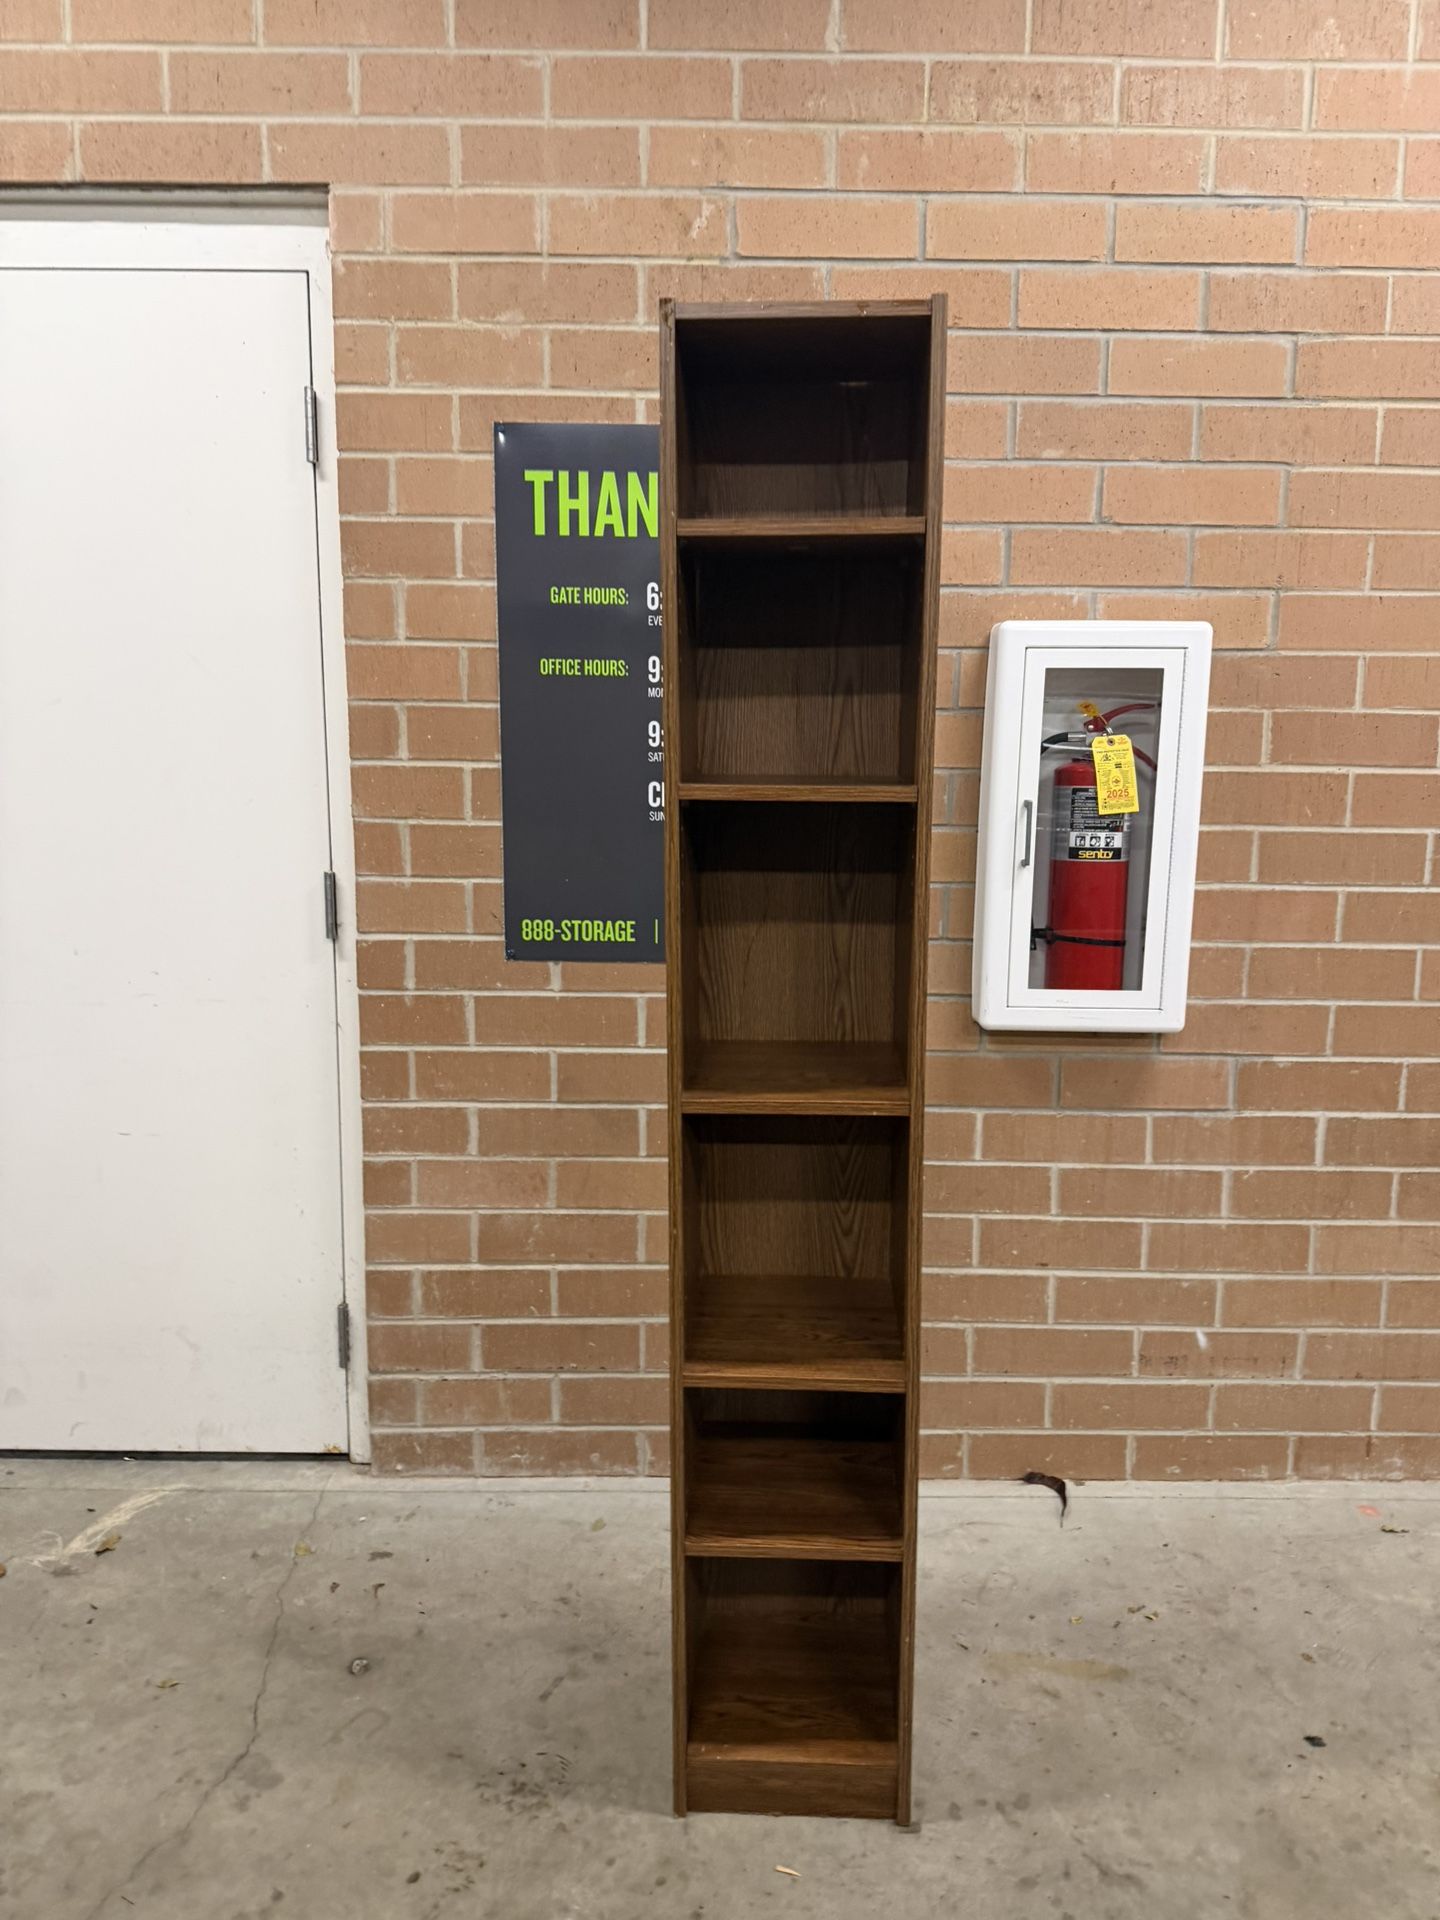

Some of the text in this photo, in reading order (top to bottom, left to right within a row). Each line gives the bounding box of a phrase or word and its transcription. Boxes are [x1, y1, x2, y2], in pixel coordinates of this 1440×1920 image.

[524, 470, 659, 538] THAN
[550, 586, 581, 604] GATE
[584, 587, 629, 605] HOURS:
[540, 658, 581, 676] OFFICE
[584, 659, 629, 677] HOURS:
[648, 751, 665, 762] SAT
[1106, 788, 1130, 799] 2025
[1078, 849, 1114, 859] sentry
[521, 918, 636, 942] 888-STORAGE
